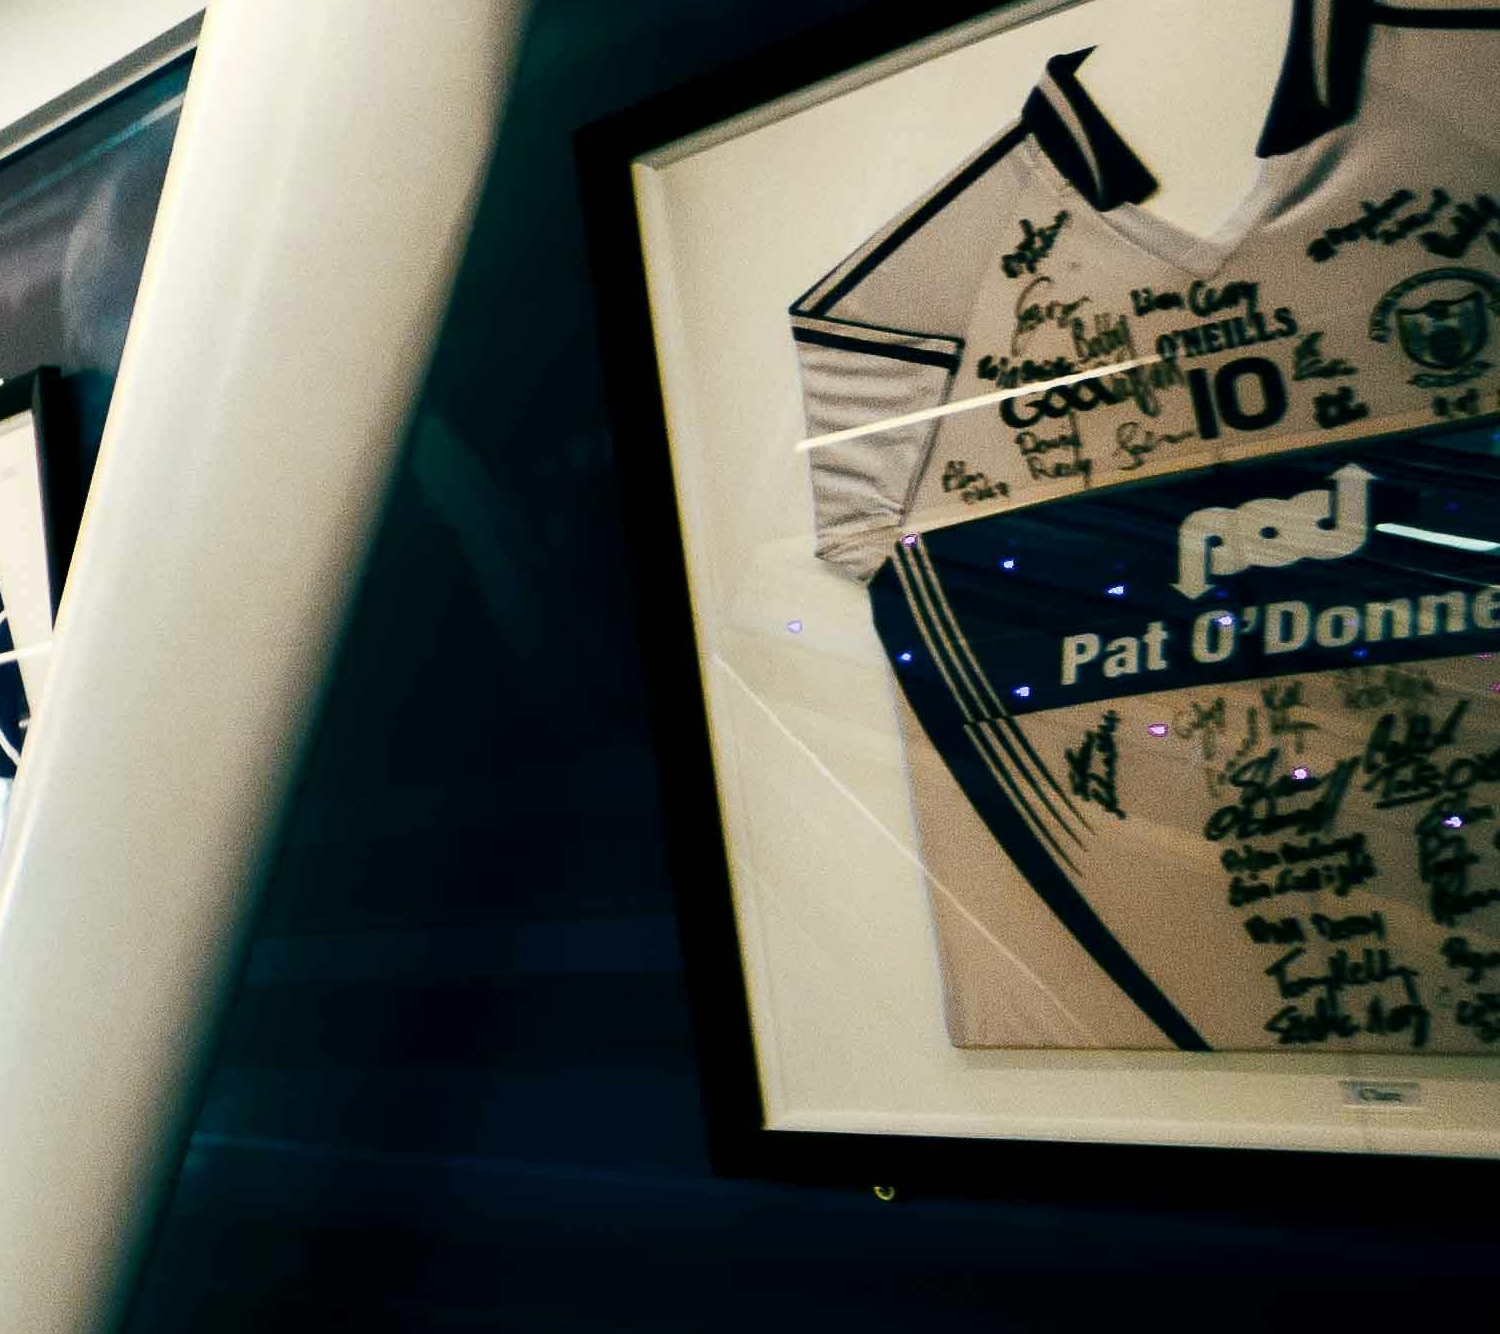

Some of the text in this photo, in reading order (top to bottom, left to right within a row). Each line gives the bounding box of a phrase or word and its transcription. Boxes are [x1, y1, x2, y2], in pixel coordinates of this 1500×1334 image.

[1156, 308, 1297, 359] O'NEILLS
[1187, 357, 1289, 439] 10
[1060, 586, 1500, 685] Pat O'Donne
